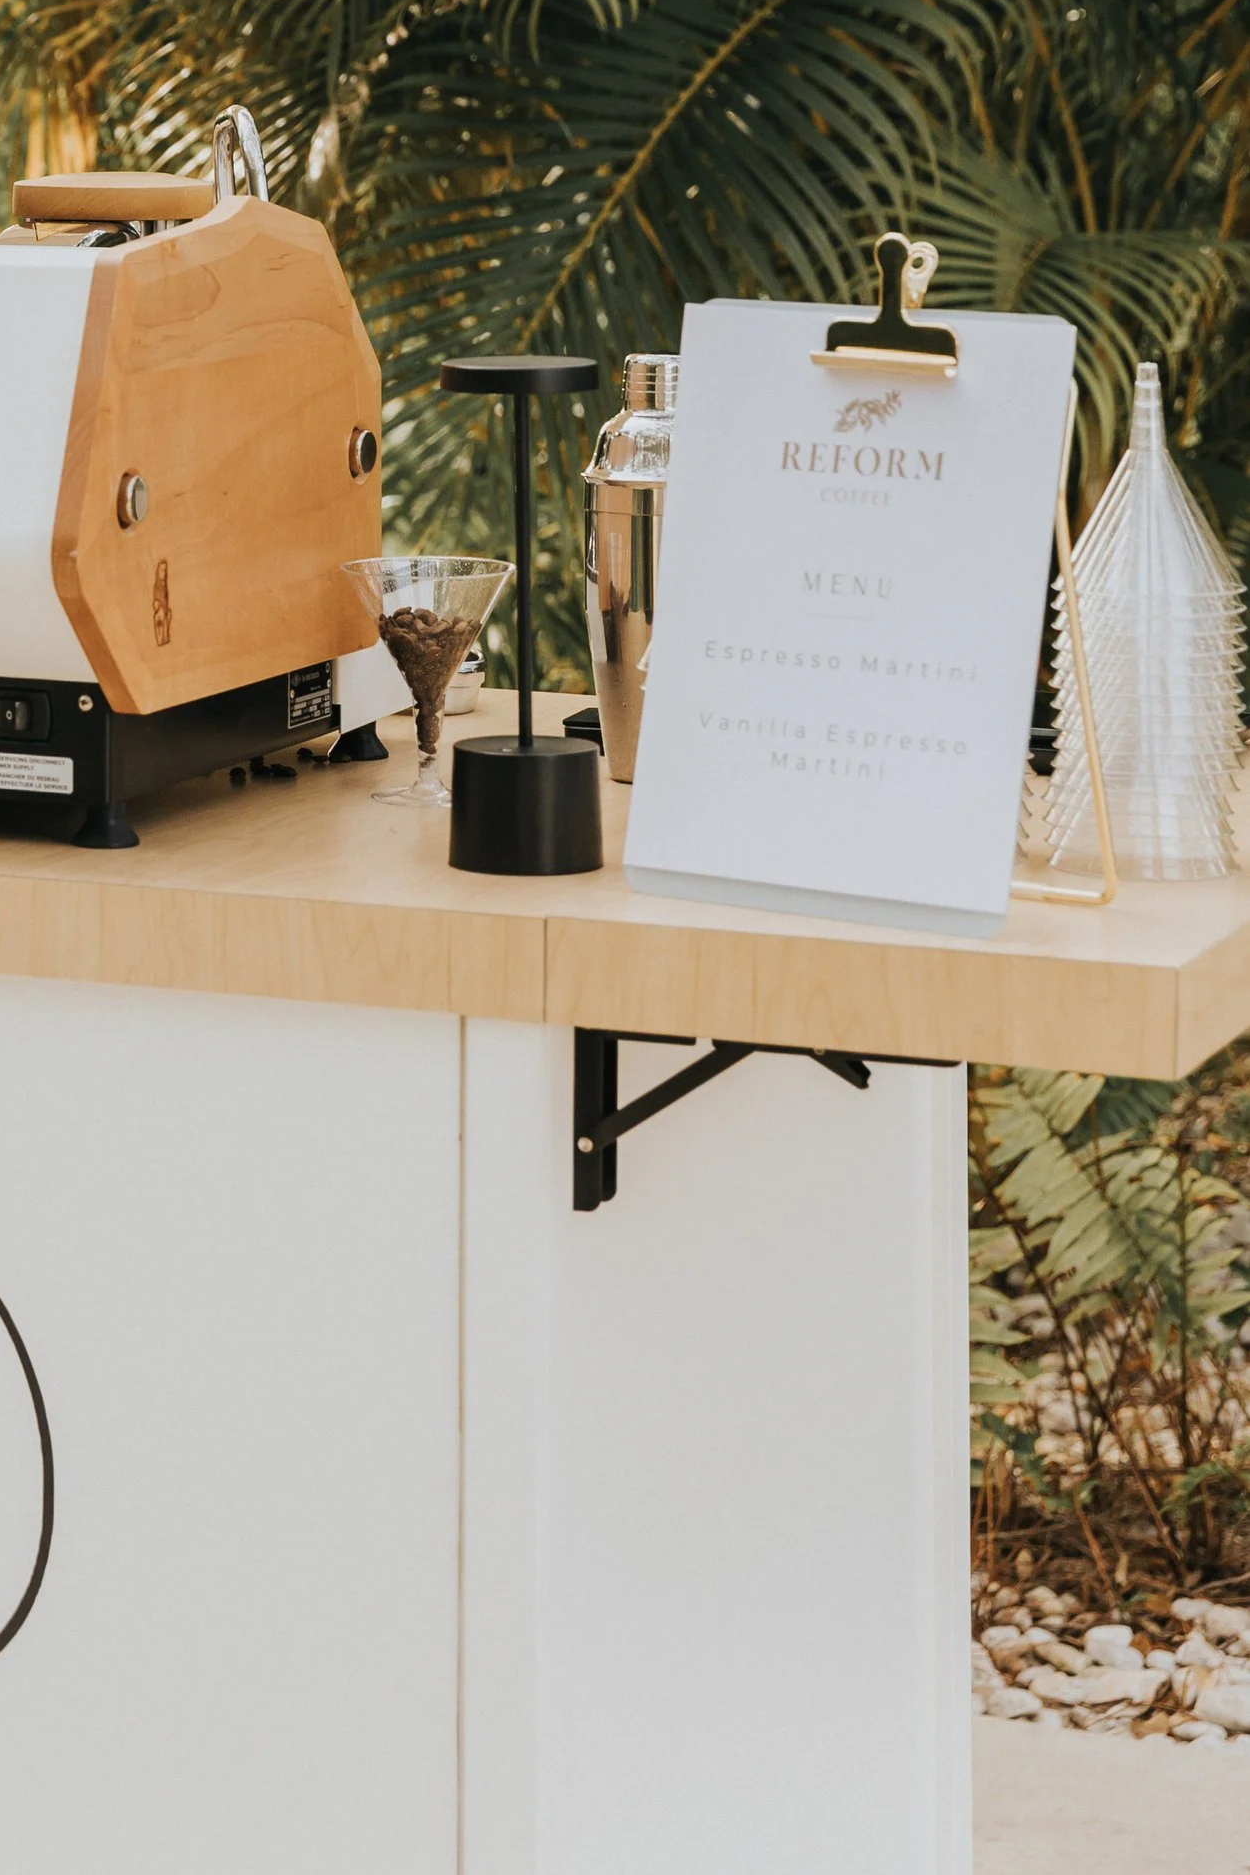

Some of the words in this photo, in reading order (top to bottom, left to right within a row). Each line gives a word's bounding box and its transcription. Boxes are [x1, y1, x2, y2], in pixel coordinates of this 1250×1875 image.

[780, 440, 947, 481] REFORM
[820, 486, 894, 507] COFFEE
[801, 570, 893, 600] MENU
[703, 639, 841, 671] Espresso
[859, 655, 979, 683] Martini
[698, 711, 808, 741] Vanilla
[825, 723, 968, 757] Espresso
[770, 751, 886, 781] Martini
